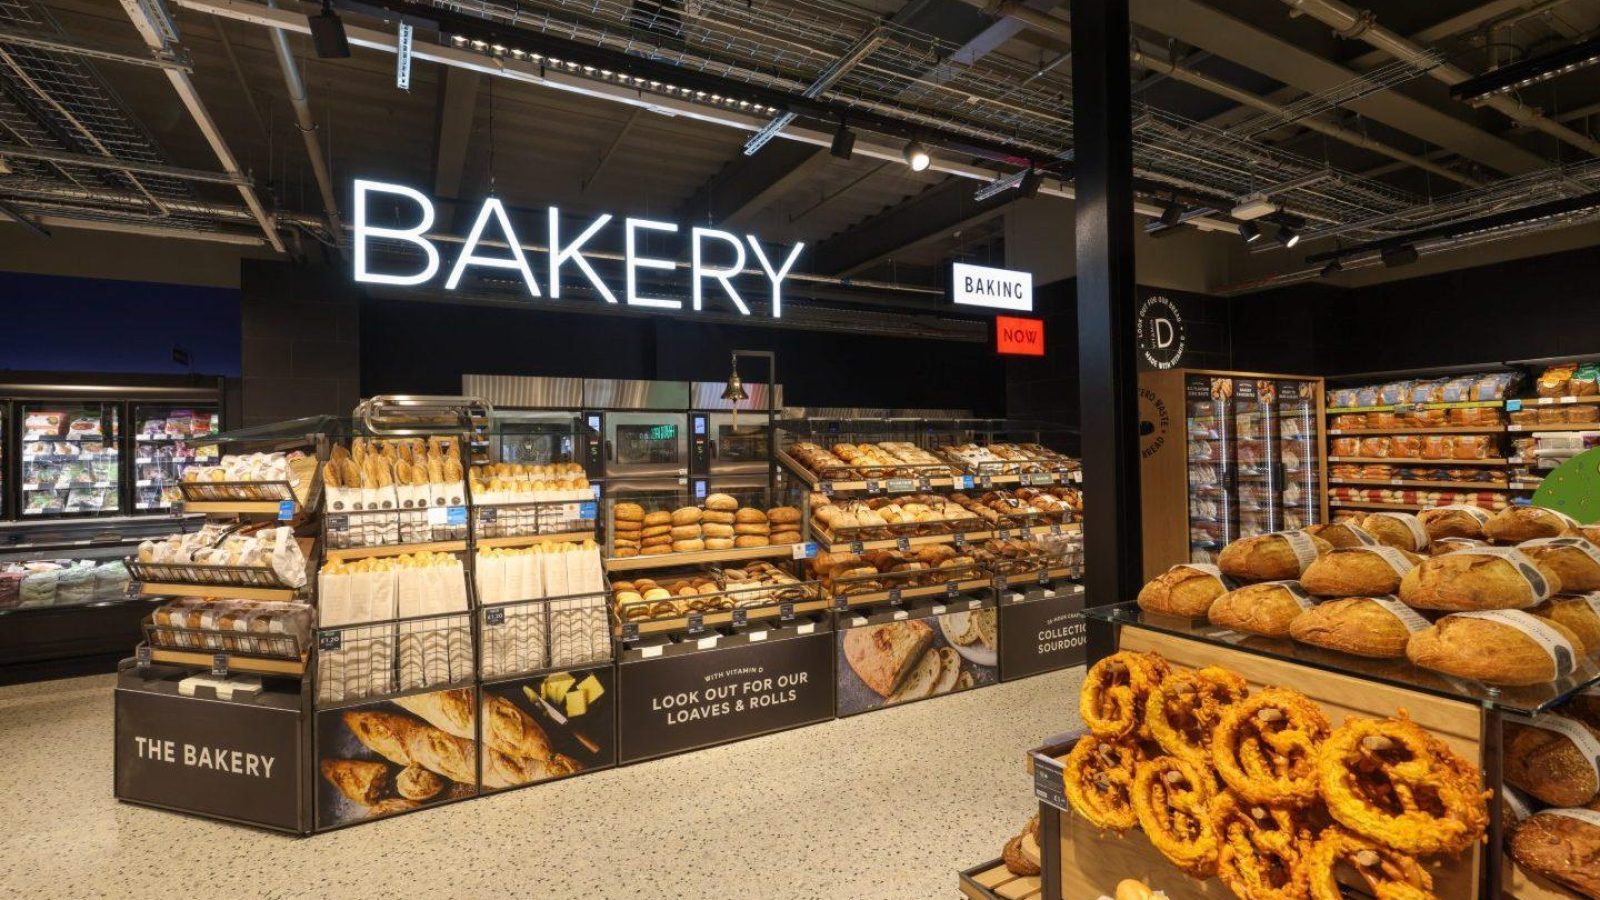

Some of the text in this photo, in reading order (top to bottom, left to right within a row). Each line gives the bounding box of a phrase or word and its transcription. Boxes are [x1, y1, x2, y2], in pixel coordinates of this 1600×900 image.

[353, 179, 805, 318] BAKERY
[965, 276, 1023, 299] BAKING
[1140, 303, 1148, 317] OUT
[1147, 296, 1157, 306] FOR
[1158, 296, 1169, 305] OUR
[1169, 302, 1181, 322] BREAD
[1003, 328, 1037, 344] NOW
[1155, 318, 1173, 348] D
[1145, 351, 1158, 368] MADE
[1159, 362, 1171, 370] WITH
[1155, 399, 1169, 427] WASTE
[704, 671, 724, 682] WITH
[725, 667, 757, 677] VITAMIN
[652, 672, 809, 711] LOOK OUT FOR OUR
[667, 689, 797, 725] LOAVES & ROLLS
[135, 736, 275, 779] THE BAKERY
